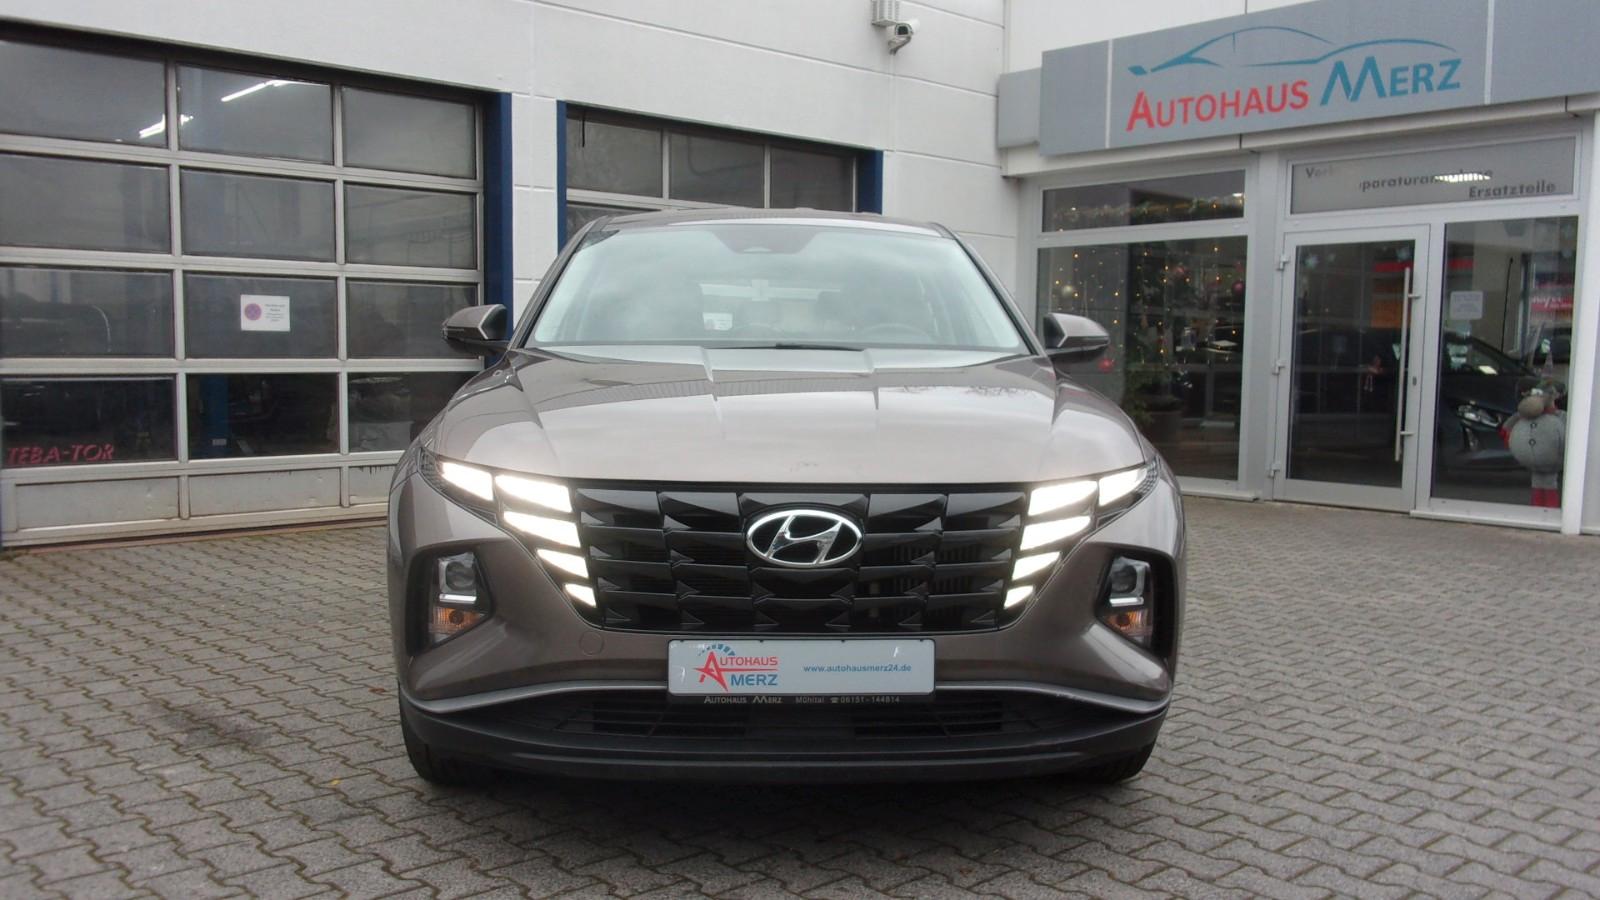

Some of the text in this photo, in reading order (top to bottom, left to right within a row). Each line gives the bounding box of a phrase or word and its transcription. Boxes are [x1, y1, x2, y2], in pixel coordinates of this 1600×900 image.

[1126, 56, 1463, 131] AUTOHAUS MERZ
[1468, 179, 1556, 199] Ersatzteile
[7, 443, 115, 465] TEBA-TOR
[803, 663, 912, 673] www.autohausmerz24.de
[730, 673, 778, 686] MERZ
[703, 695, 748, 704] AUTOHAUS
[752, 695, 783, 704] MERZ
